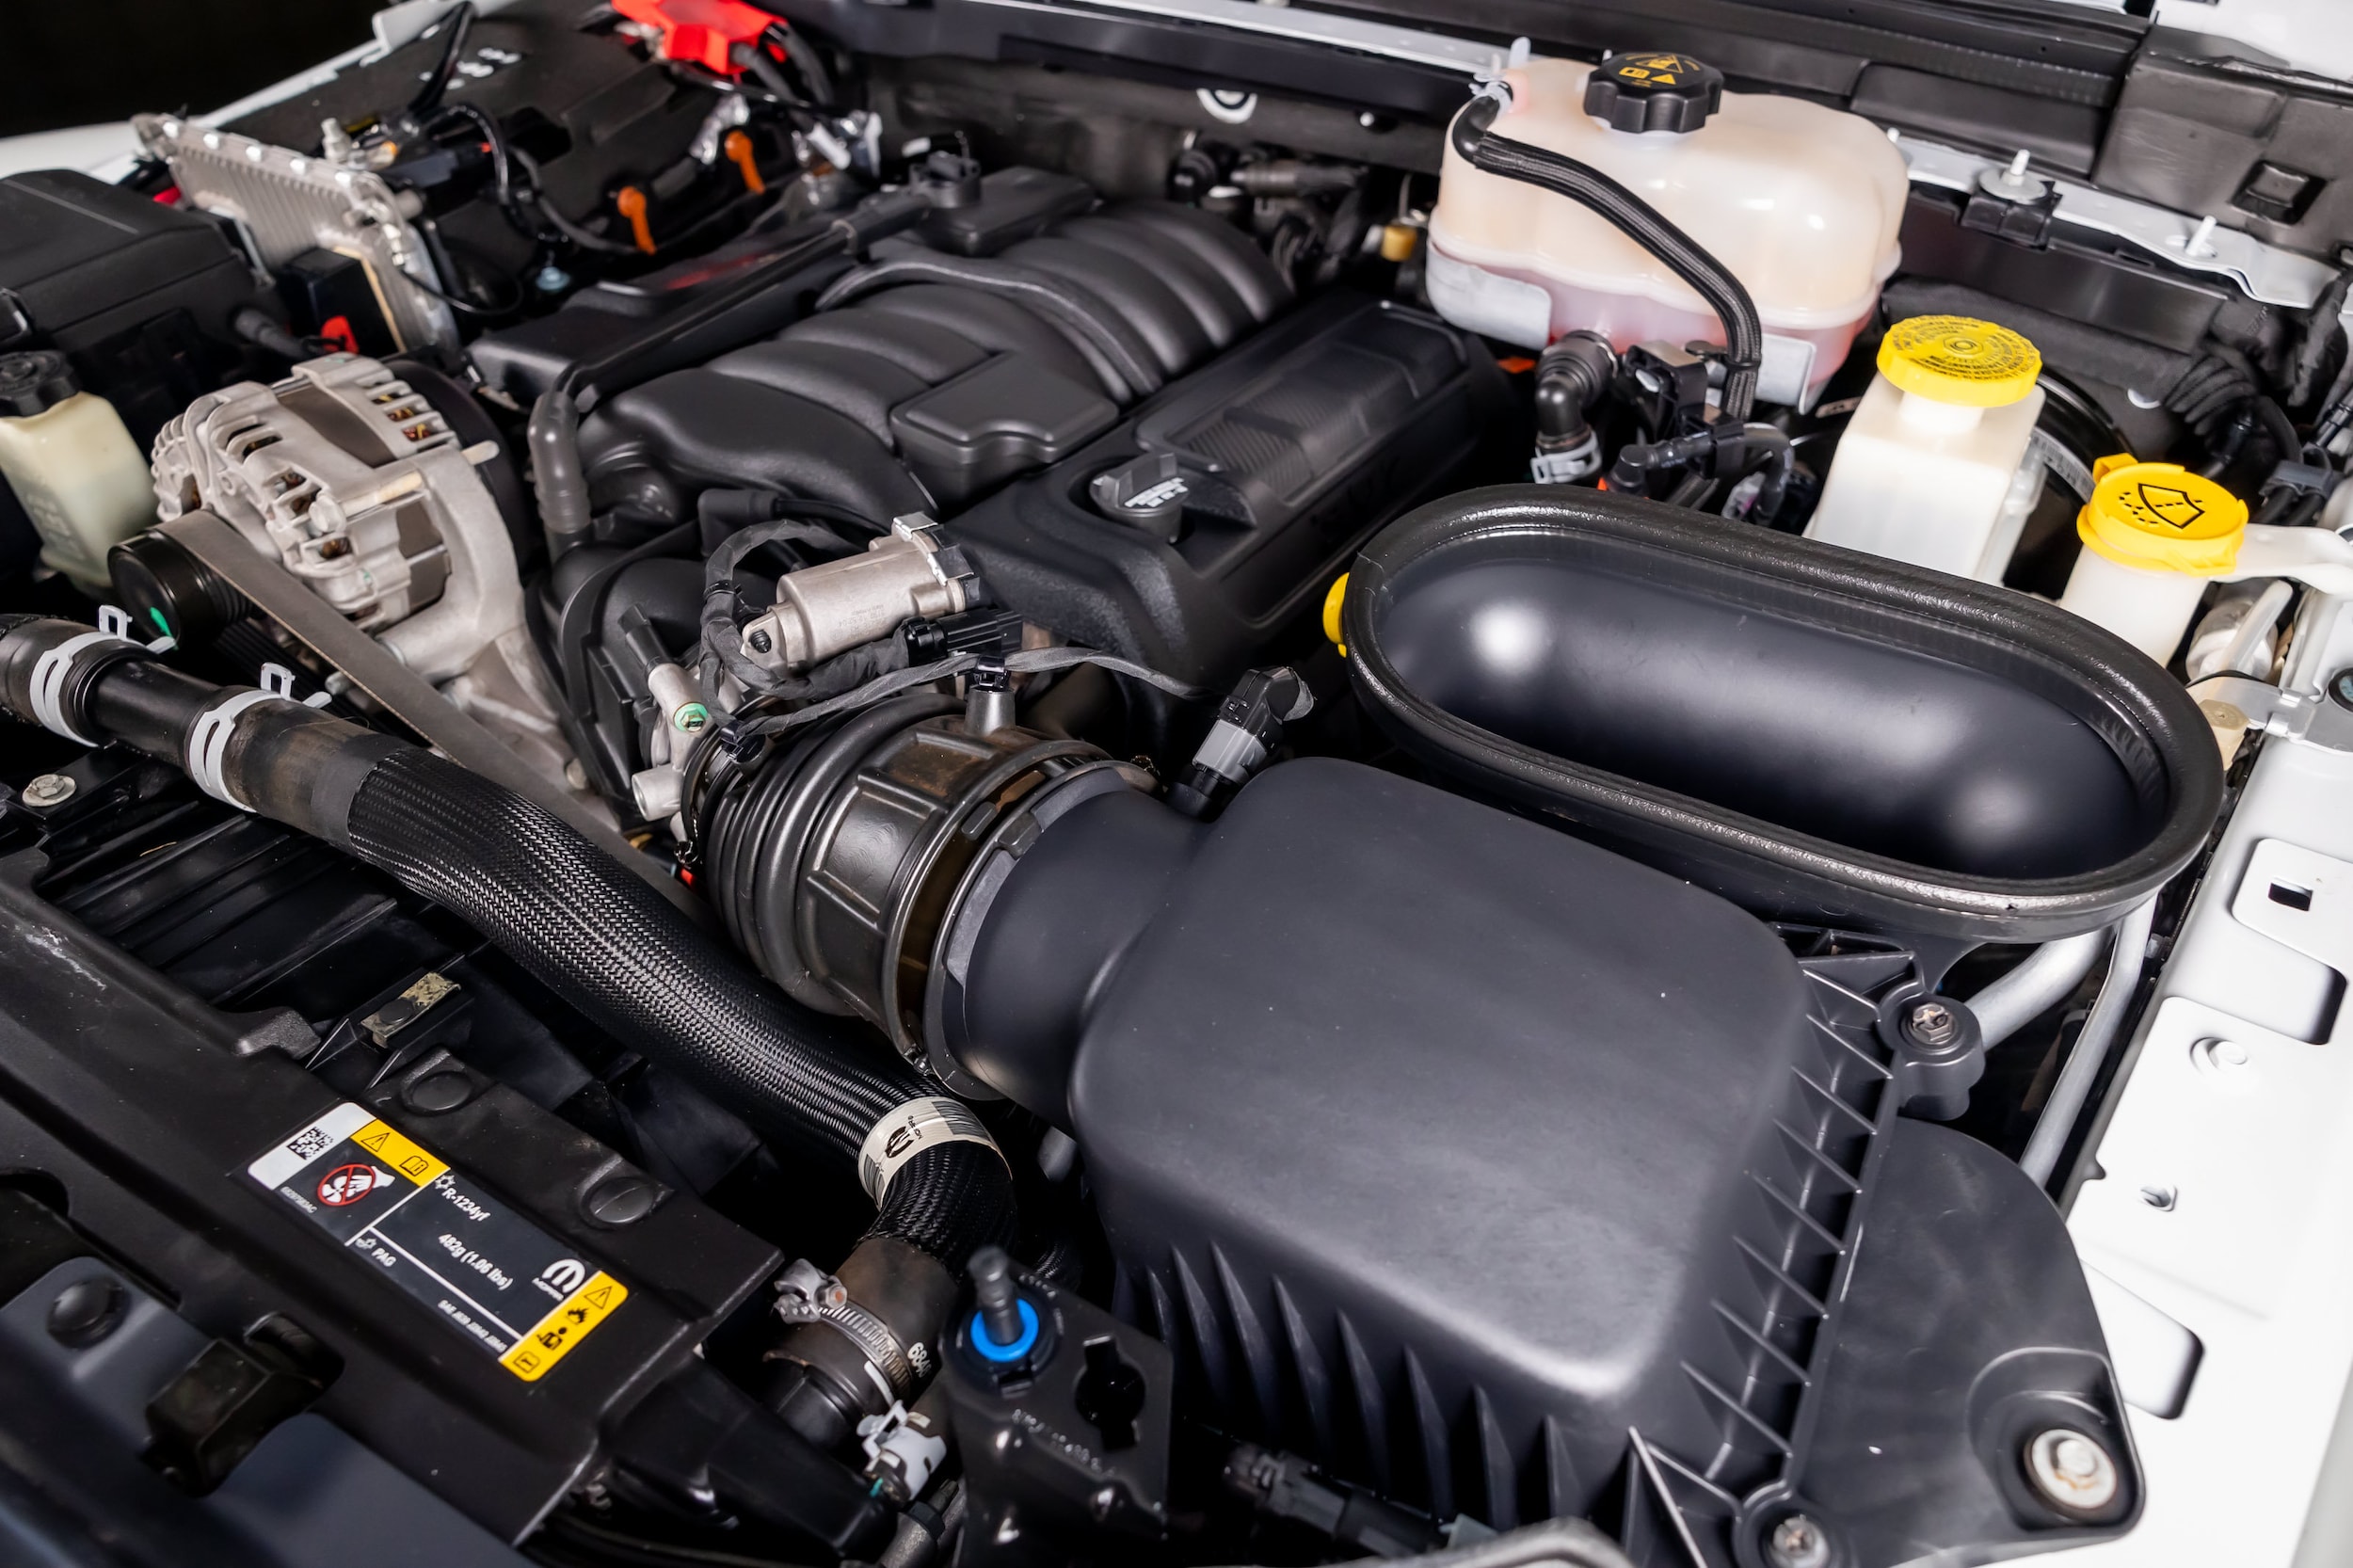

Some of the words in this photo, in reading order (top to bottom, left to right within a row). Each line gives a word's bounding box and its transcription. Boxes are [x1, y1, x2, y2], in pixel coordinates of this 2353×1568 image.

[441, 1187, 491, 1222] R-1234yf
[371, 1247, 396, 1268] PAG
[438, 1233, 467, 1258] 482g
[459, 1250, 493, 1274] (1.06
[487, 1268, 514, 1291] lbs)
[437, 1299, 457, 1315] SAE
